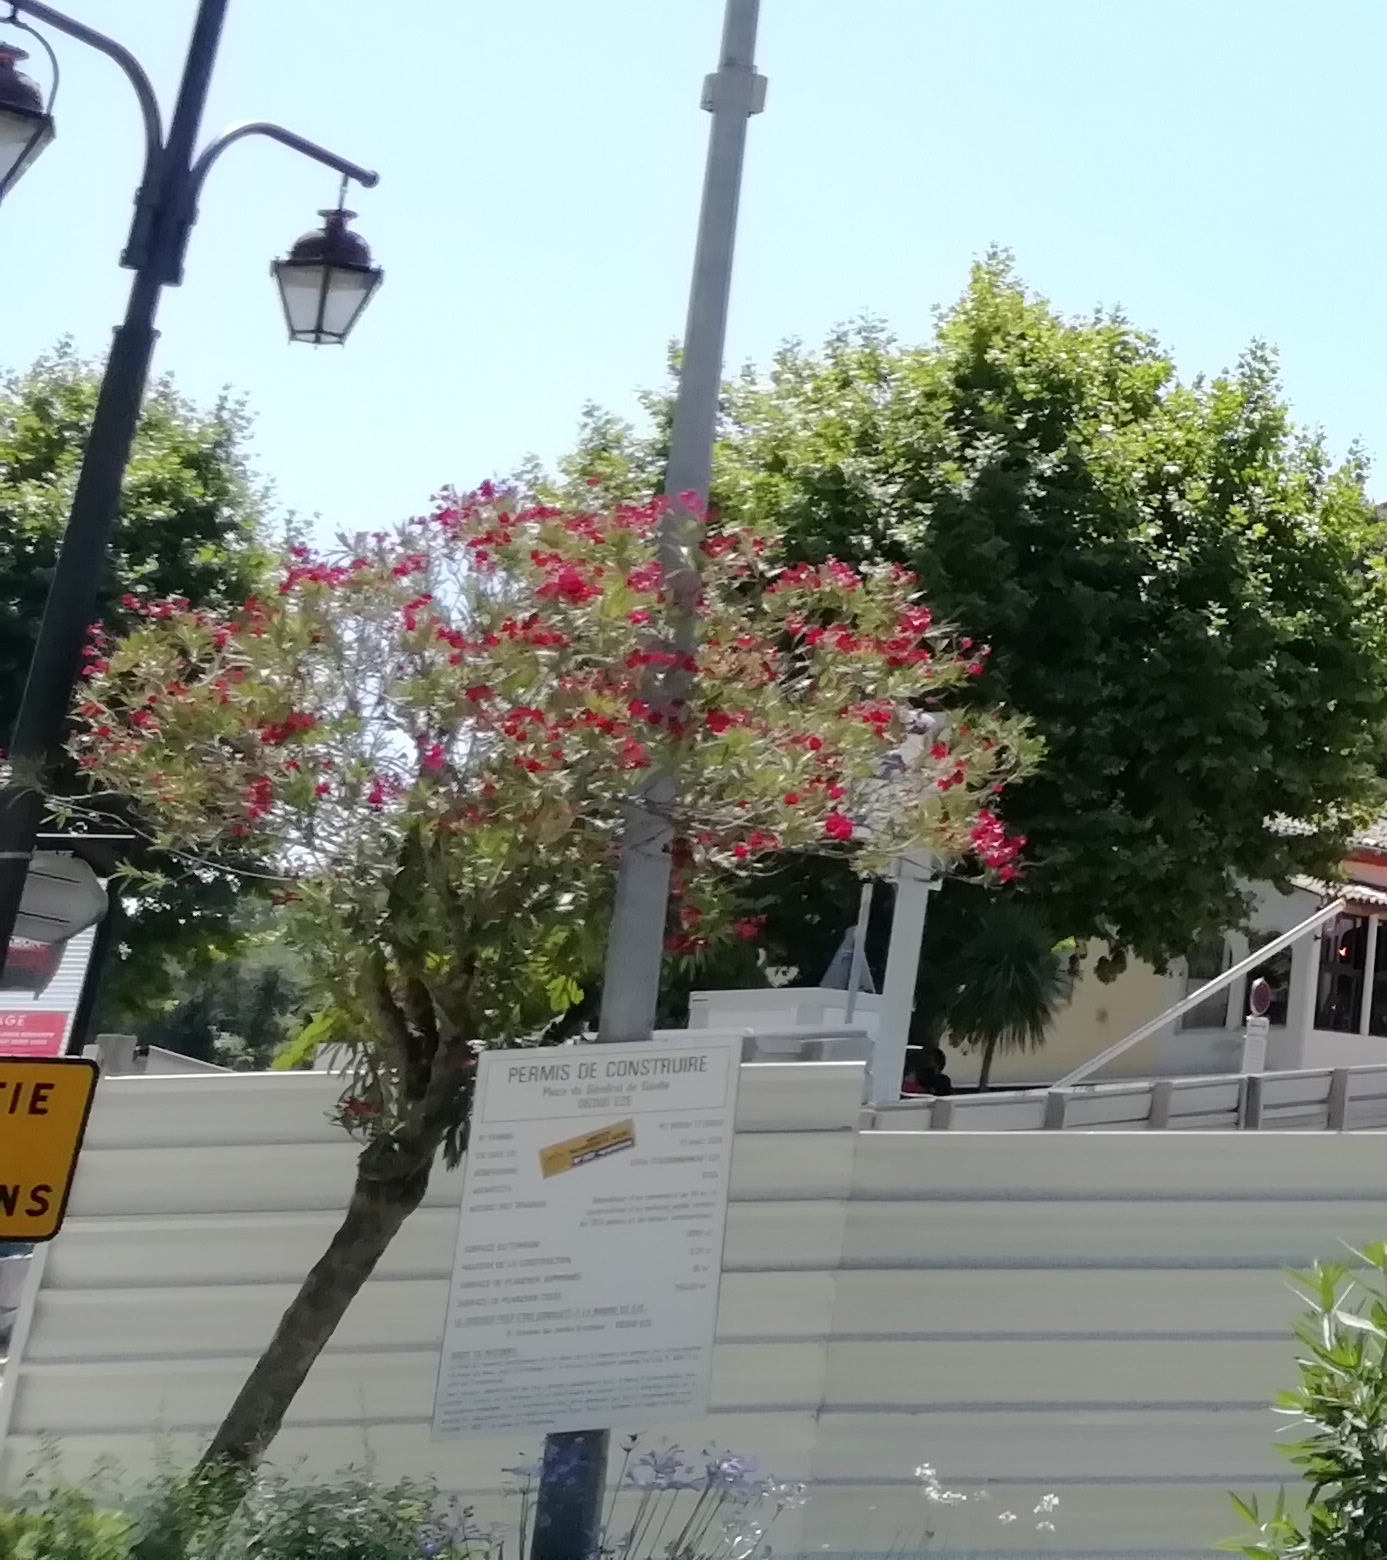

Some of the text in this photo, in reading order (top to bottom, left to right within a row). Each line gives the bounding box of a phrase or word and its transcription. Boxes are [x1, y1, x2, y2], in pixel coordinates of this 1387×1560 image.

[508, 1055, 709, 1083] PERMIS DE CONSTRUIRE
[0, 1082, 56, 1116] IE
